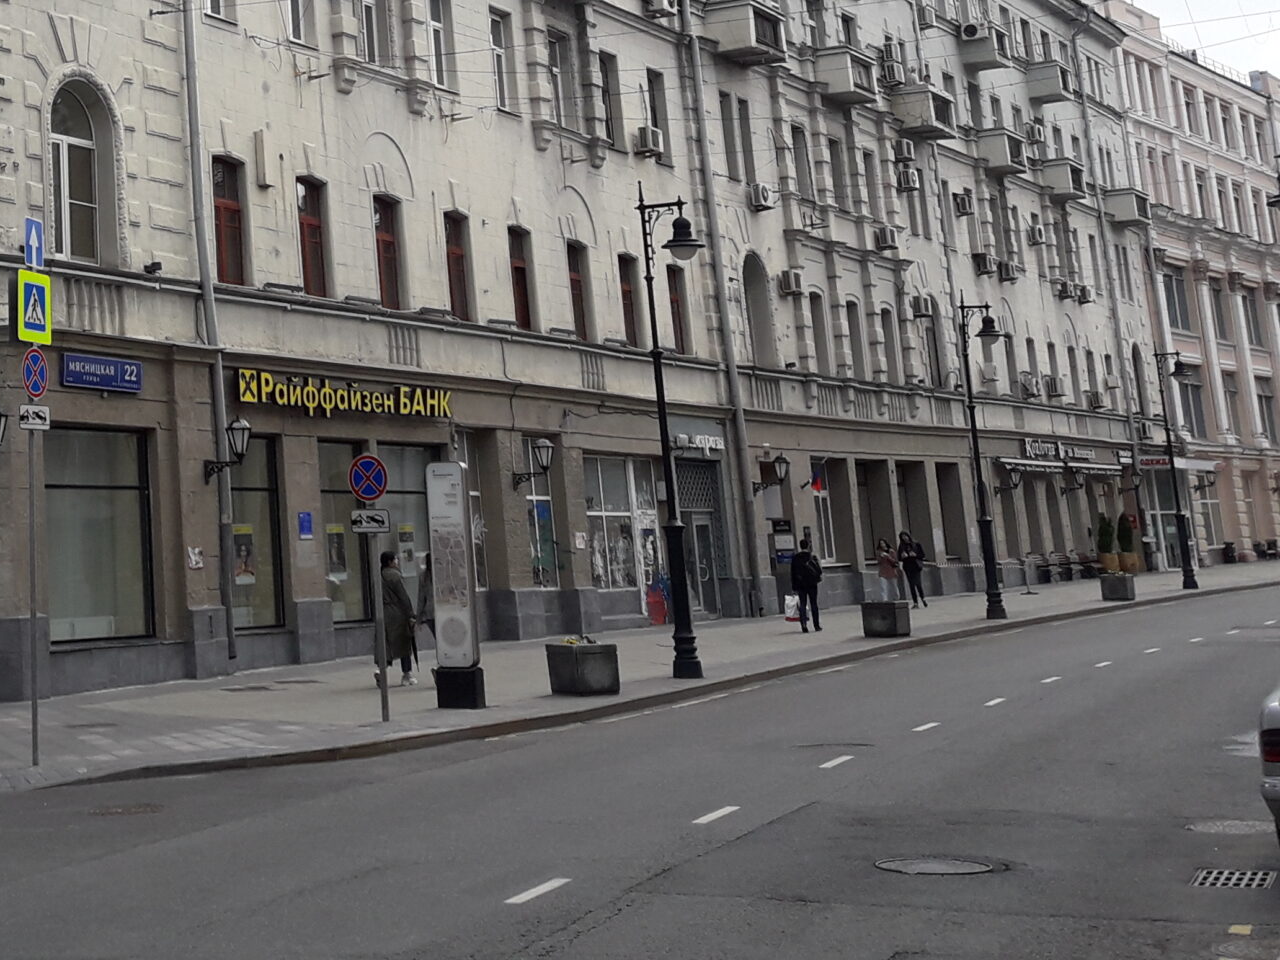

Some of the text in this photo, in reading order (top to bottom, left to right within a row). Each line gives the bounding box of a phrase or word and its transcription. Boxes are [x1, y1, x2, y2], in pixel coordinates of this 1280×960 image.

[68, 361, 137, 381] МЯСНИЦКАЯ 22
[260, 372, 452, 418] Райффайзен БАНК
